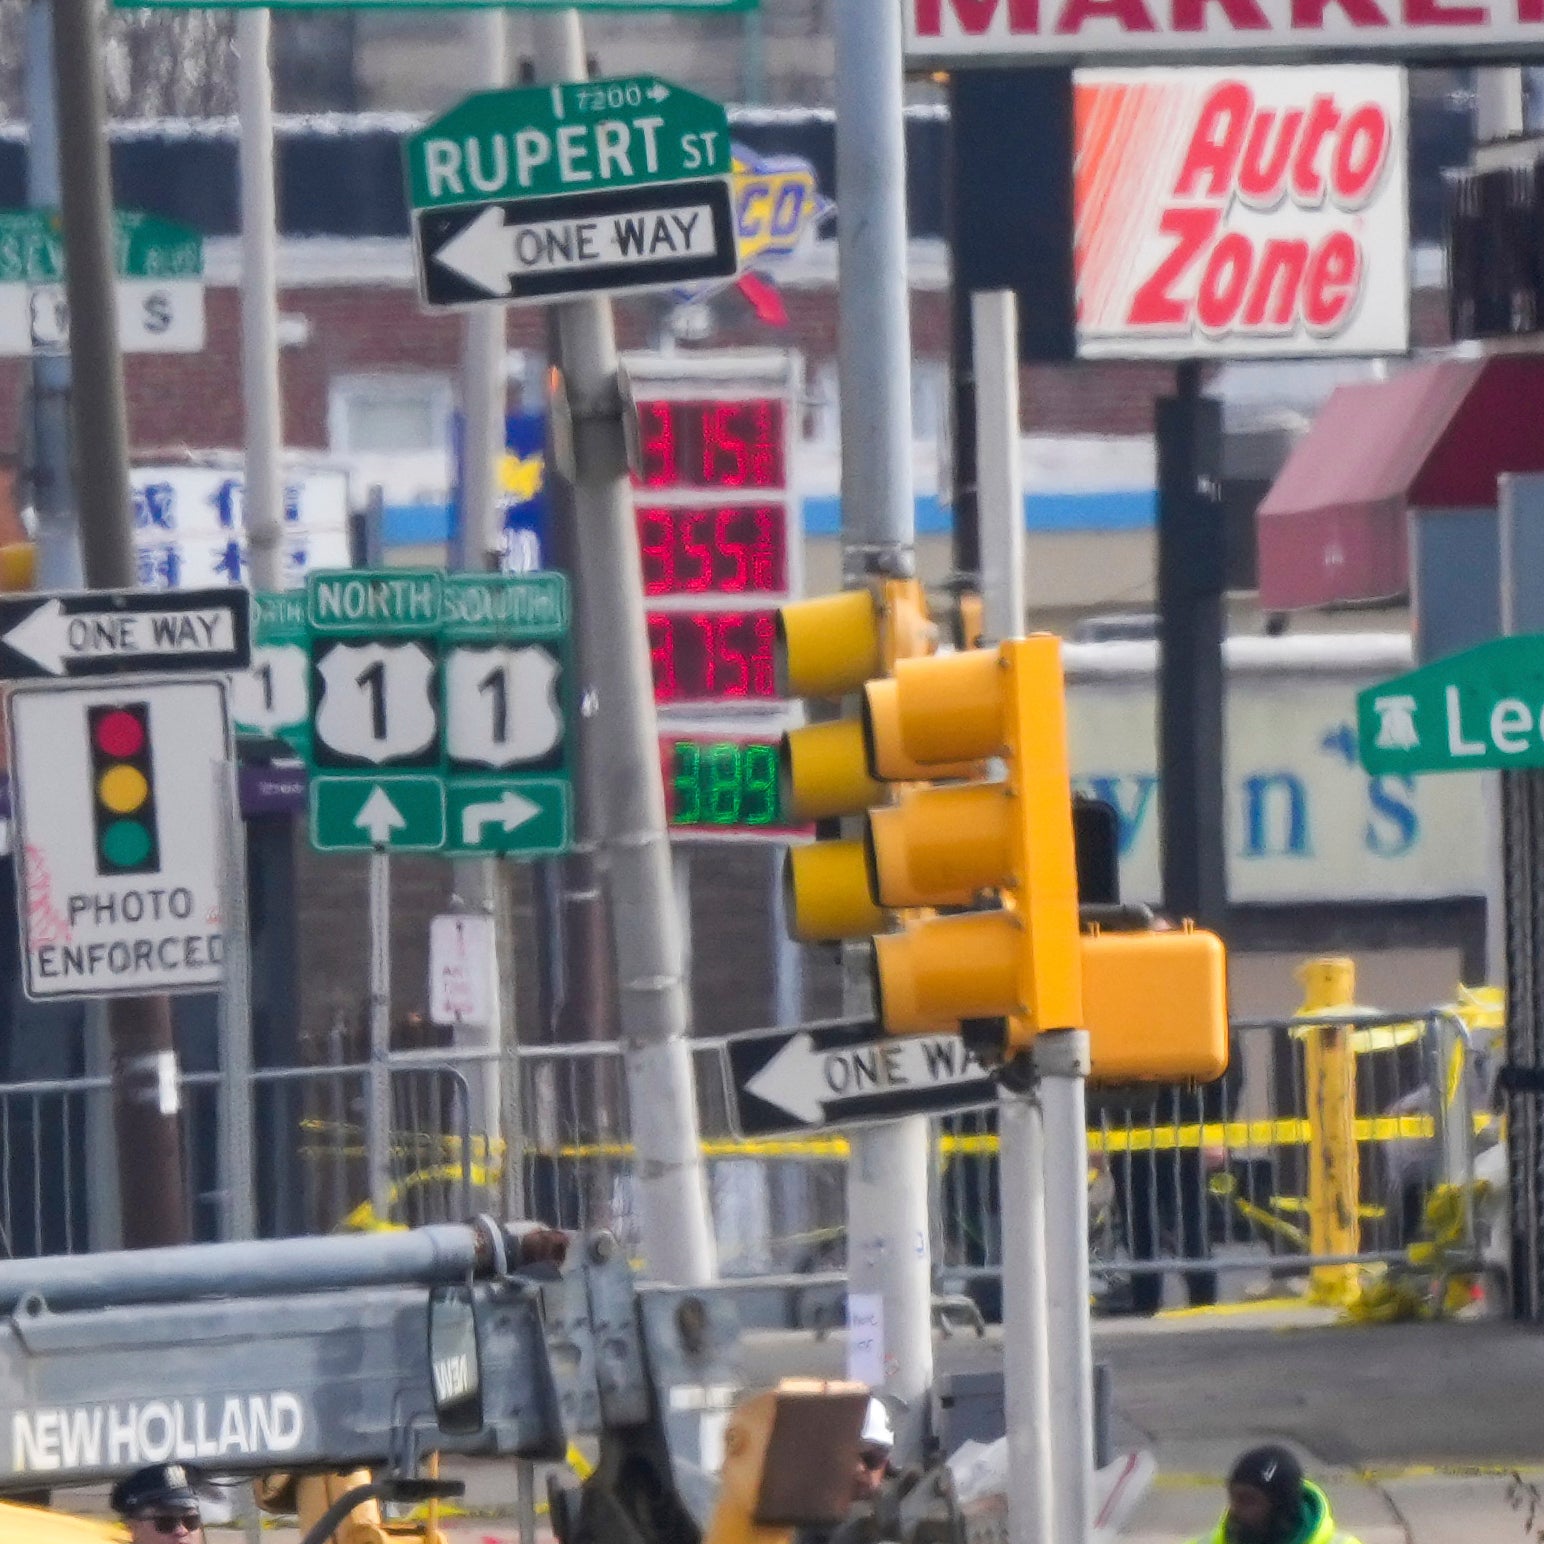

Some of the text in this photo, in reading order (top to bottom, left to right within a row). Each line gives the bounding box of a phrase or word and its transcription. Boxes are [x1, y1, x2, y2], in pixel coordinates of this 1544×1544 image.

[424, 116, 719, 199] RUPERT ST
[1173, 79, 1390, 197] Auto
[516, 211, 702, 267] ONE WAY
[1126, 207, 1364, 328] Zone
[67, 612, 219, 652] ONE WAY
[317, 581, 432, 618] NORTH
[356, 660, 387, 740] 1
[478, 665, 507, 744] 1
[69, 887, 192, 927] PHOTO
[38, 935, 224, 978] ENFORCED
[824, 1048, 908, 1095] ONE
[12, 1392, 304, 1472] NEW HOLLAND
